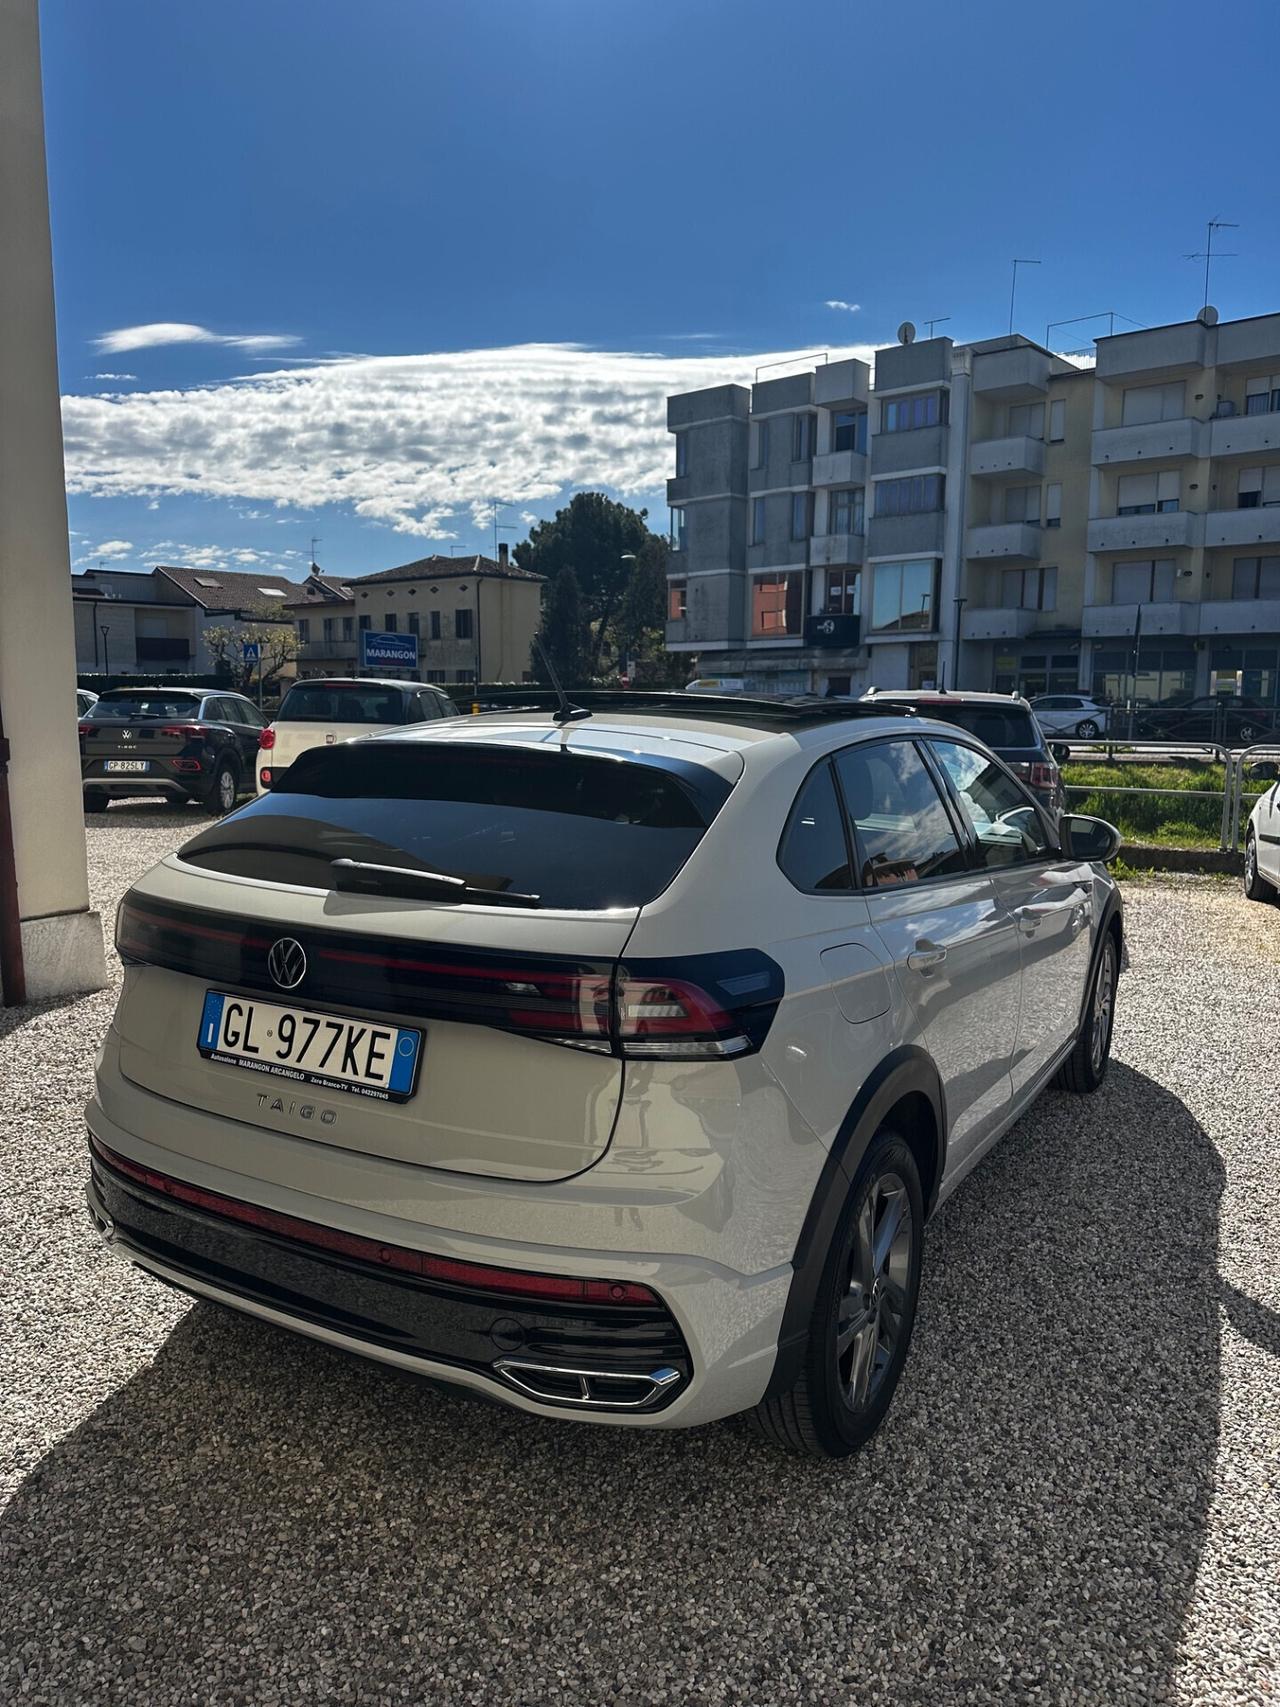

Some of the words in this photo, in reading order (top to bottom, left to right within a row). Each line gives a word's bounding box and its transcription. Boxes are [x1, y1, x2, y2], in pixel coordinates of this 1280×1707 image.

[367, 648, 416, 660] MARANGON
[223, 1003, 260, 1054] GL
[275, 1014, 392, 1082] 977KE
[238, 1059, 270, 1073] MARANGON
[270, 1066, 305, 1080] ARCANGELO
[310, 1076, 322, 1085] Zero
[322, 1079, 348, 1090] Branco-TV
[256, 1092, 338, 1126] TAIGO
